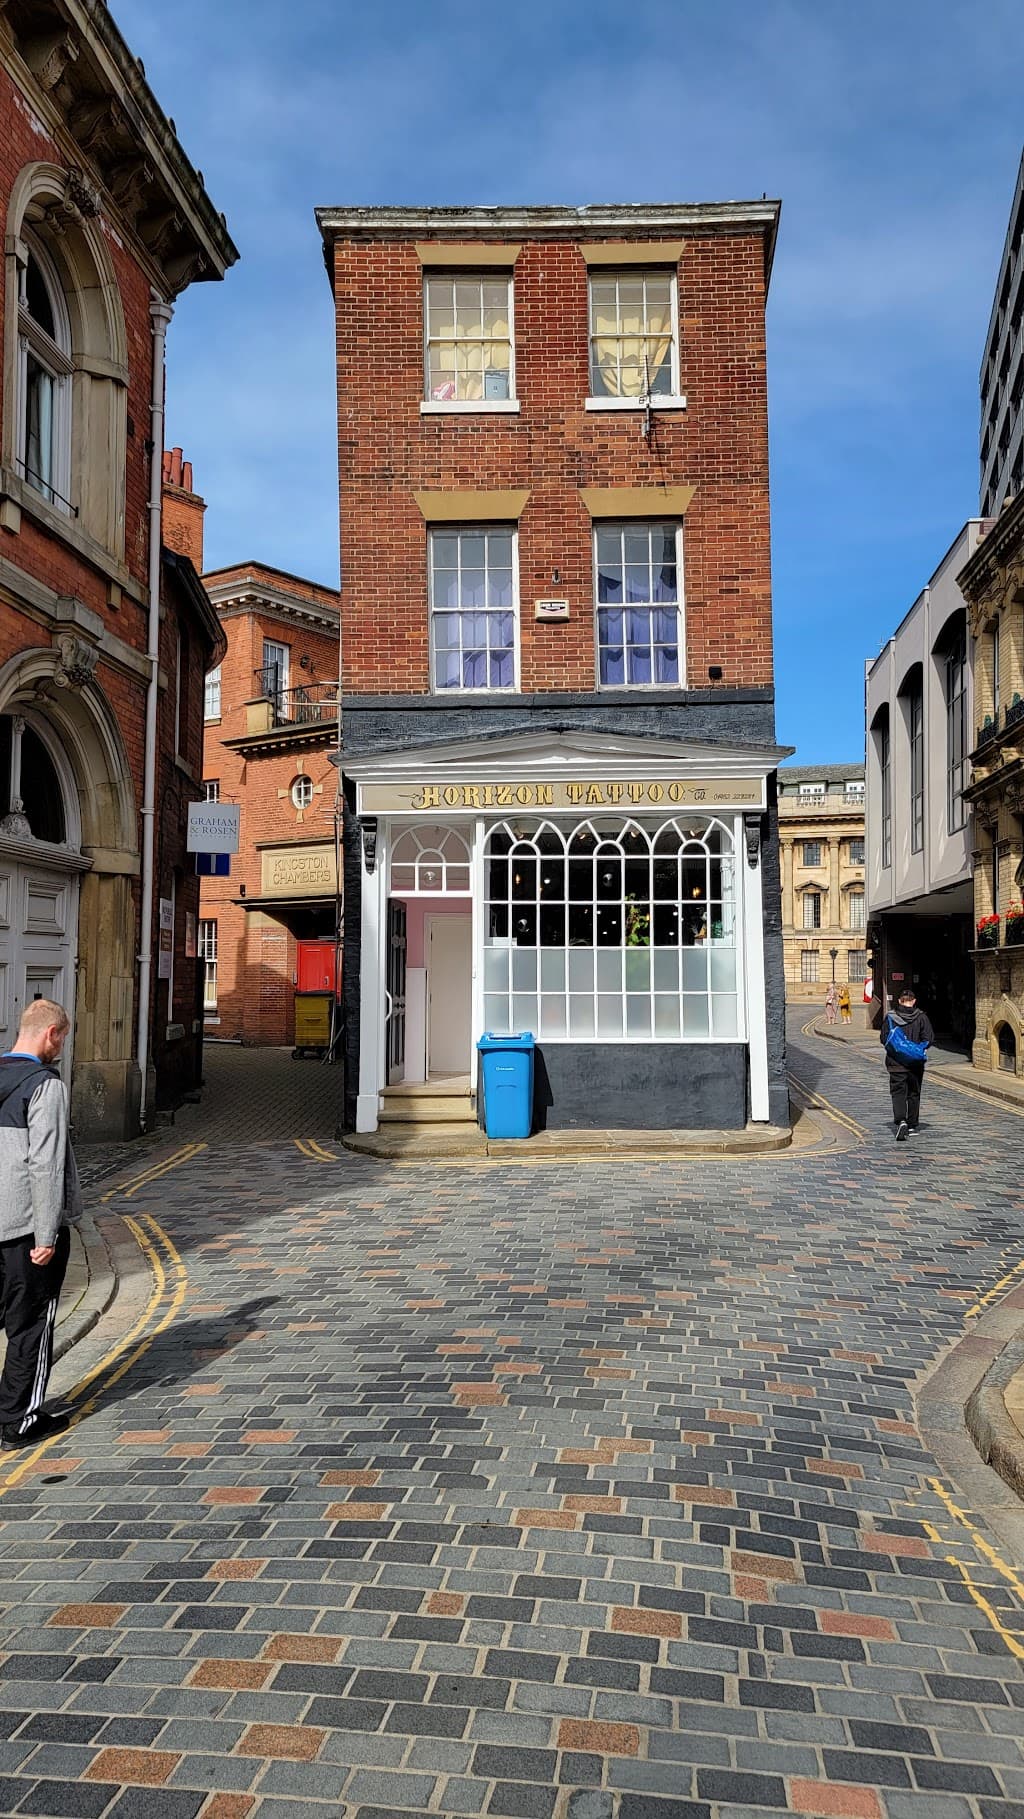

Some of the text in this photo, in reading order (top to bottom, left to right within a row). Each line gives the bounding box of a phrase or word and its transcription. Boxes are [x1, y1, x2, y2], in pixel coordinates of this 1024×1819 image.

[412, 784, 554, 809] HORIZON
[190, 817, 237, 827] GRAHAM
[190, 826, 237, 835] & ROSEN
[274, 856, 329, 872] KINGSTON
[273, 870, 331, 885] CHAMBERS
